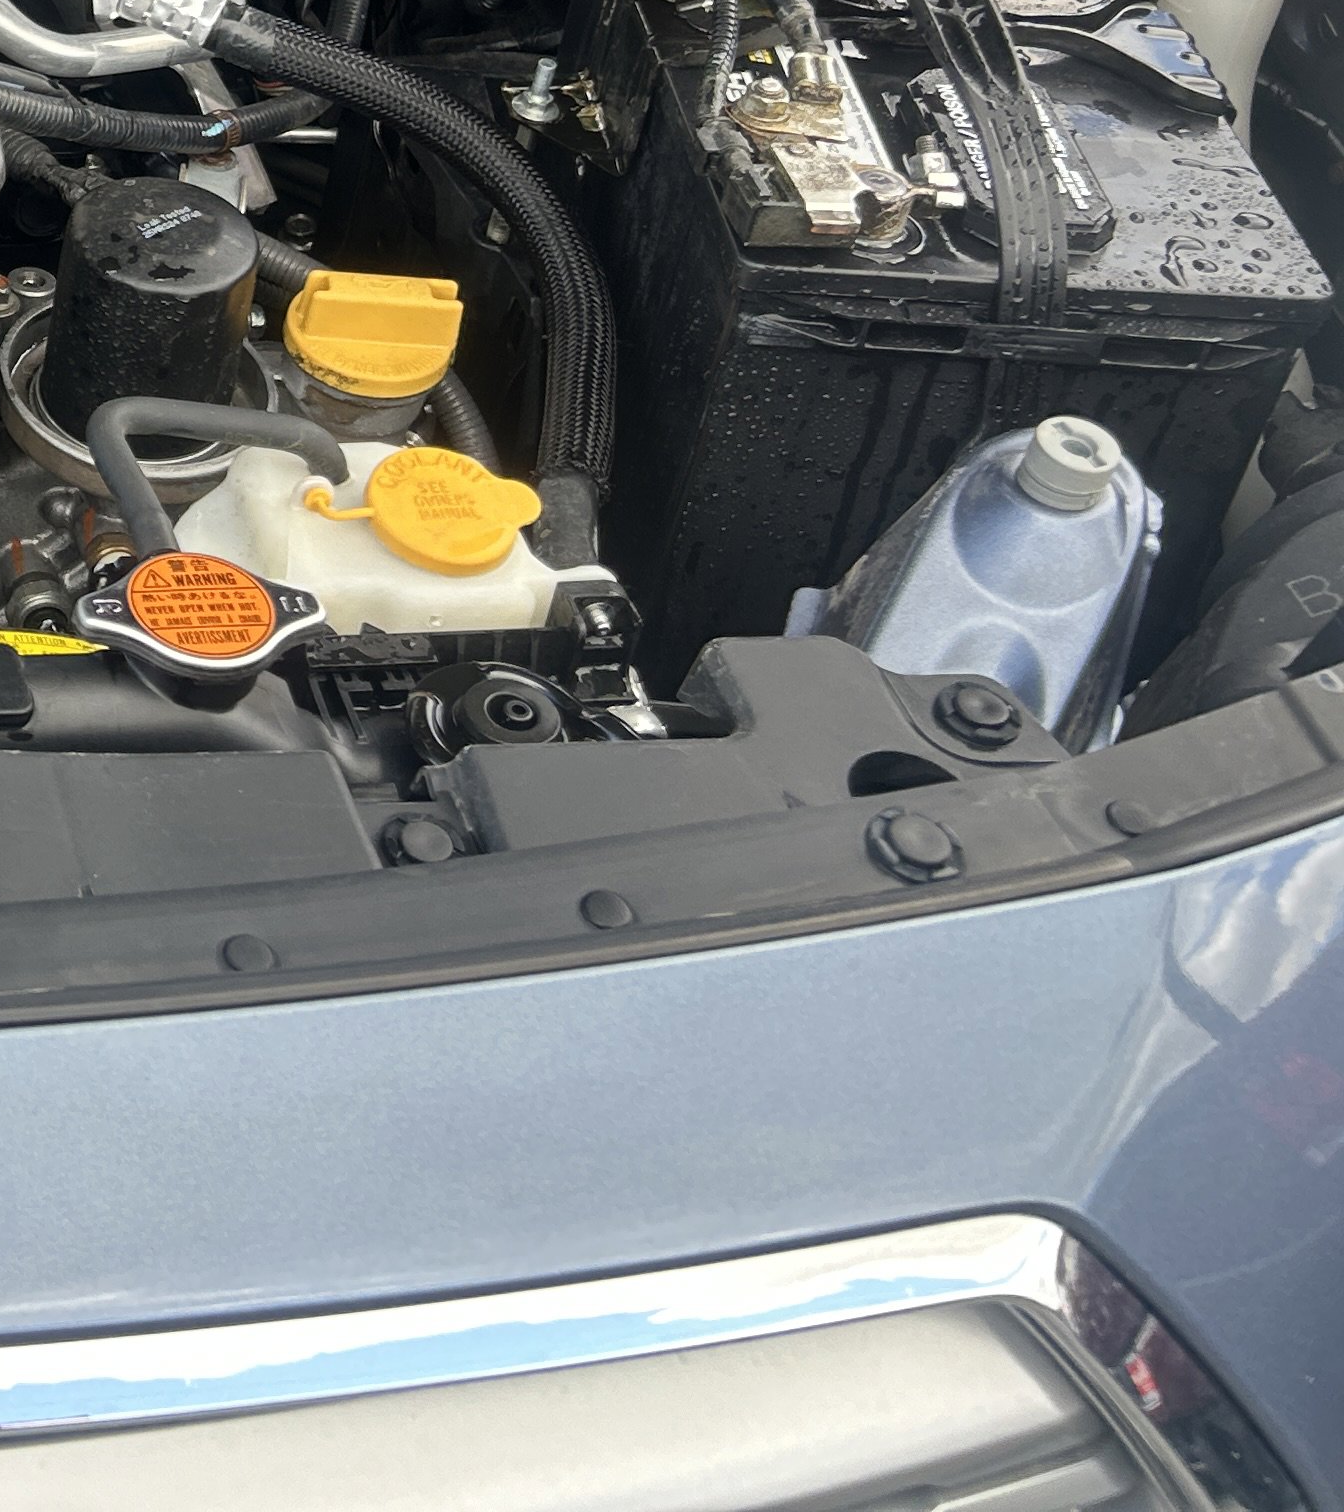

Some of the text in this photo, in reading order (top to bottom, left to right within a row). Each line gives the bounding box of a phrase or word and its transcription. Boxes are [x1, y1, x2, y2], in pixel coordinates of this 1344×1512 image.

[377, 452, 490, 489] COOLANT
[171, 572, 238, 588] WARNING
[144, 605, 177, 616] NEVER
[179, 604, 205, 614] OPEN
[206, 603, 237, 613] WHEN
[13, 633, 66, 648] ATTENTION
